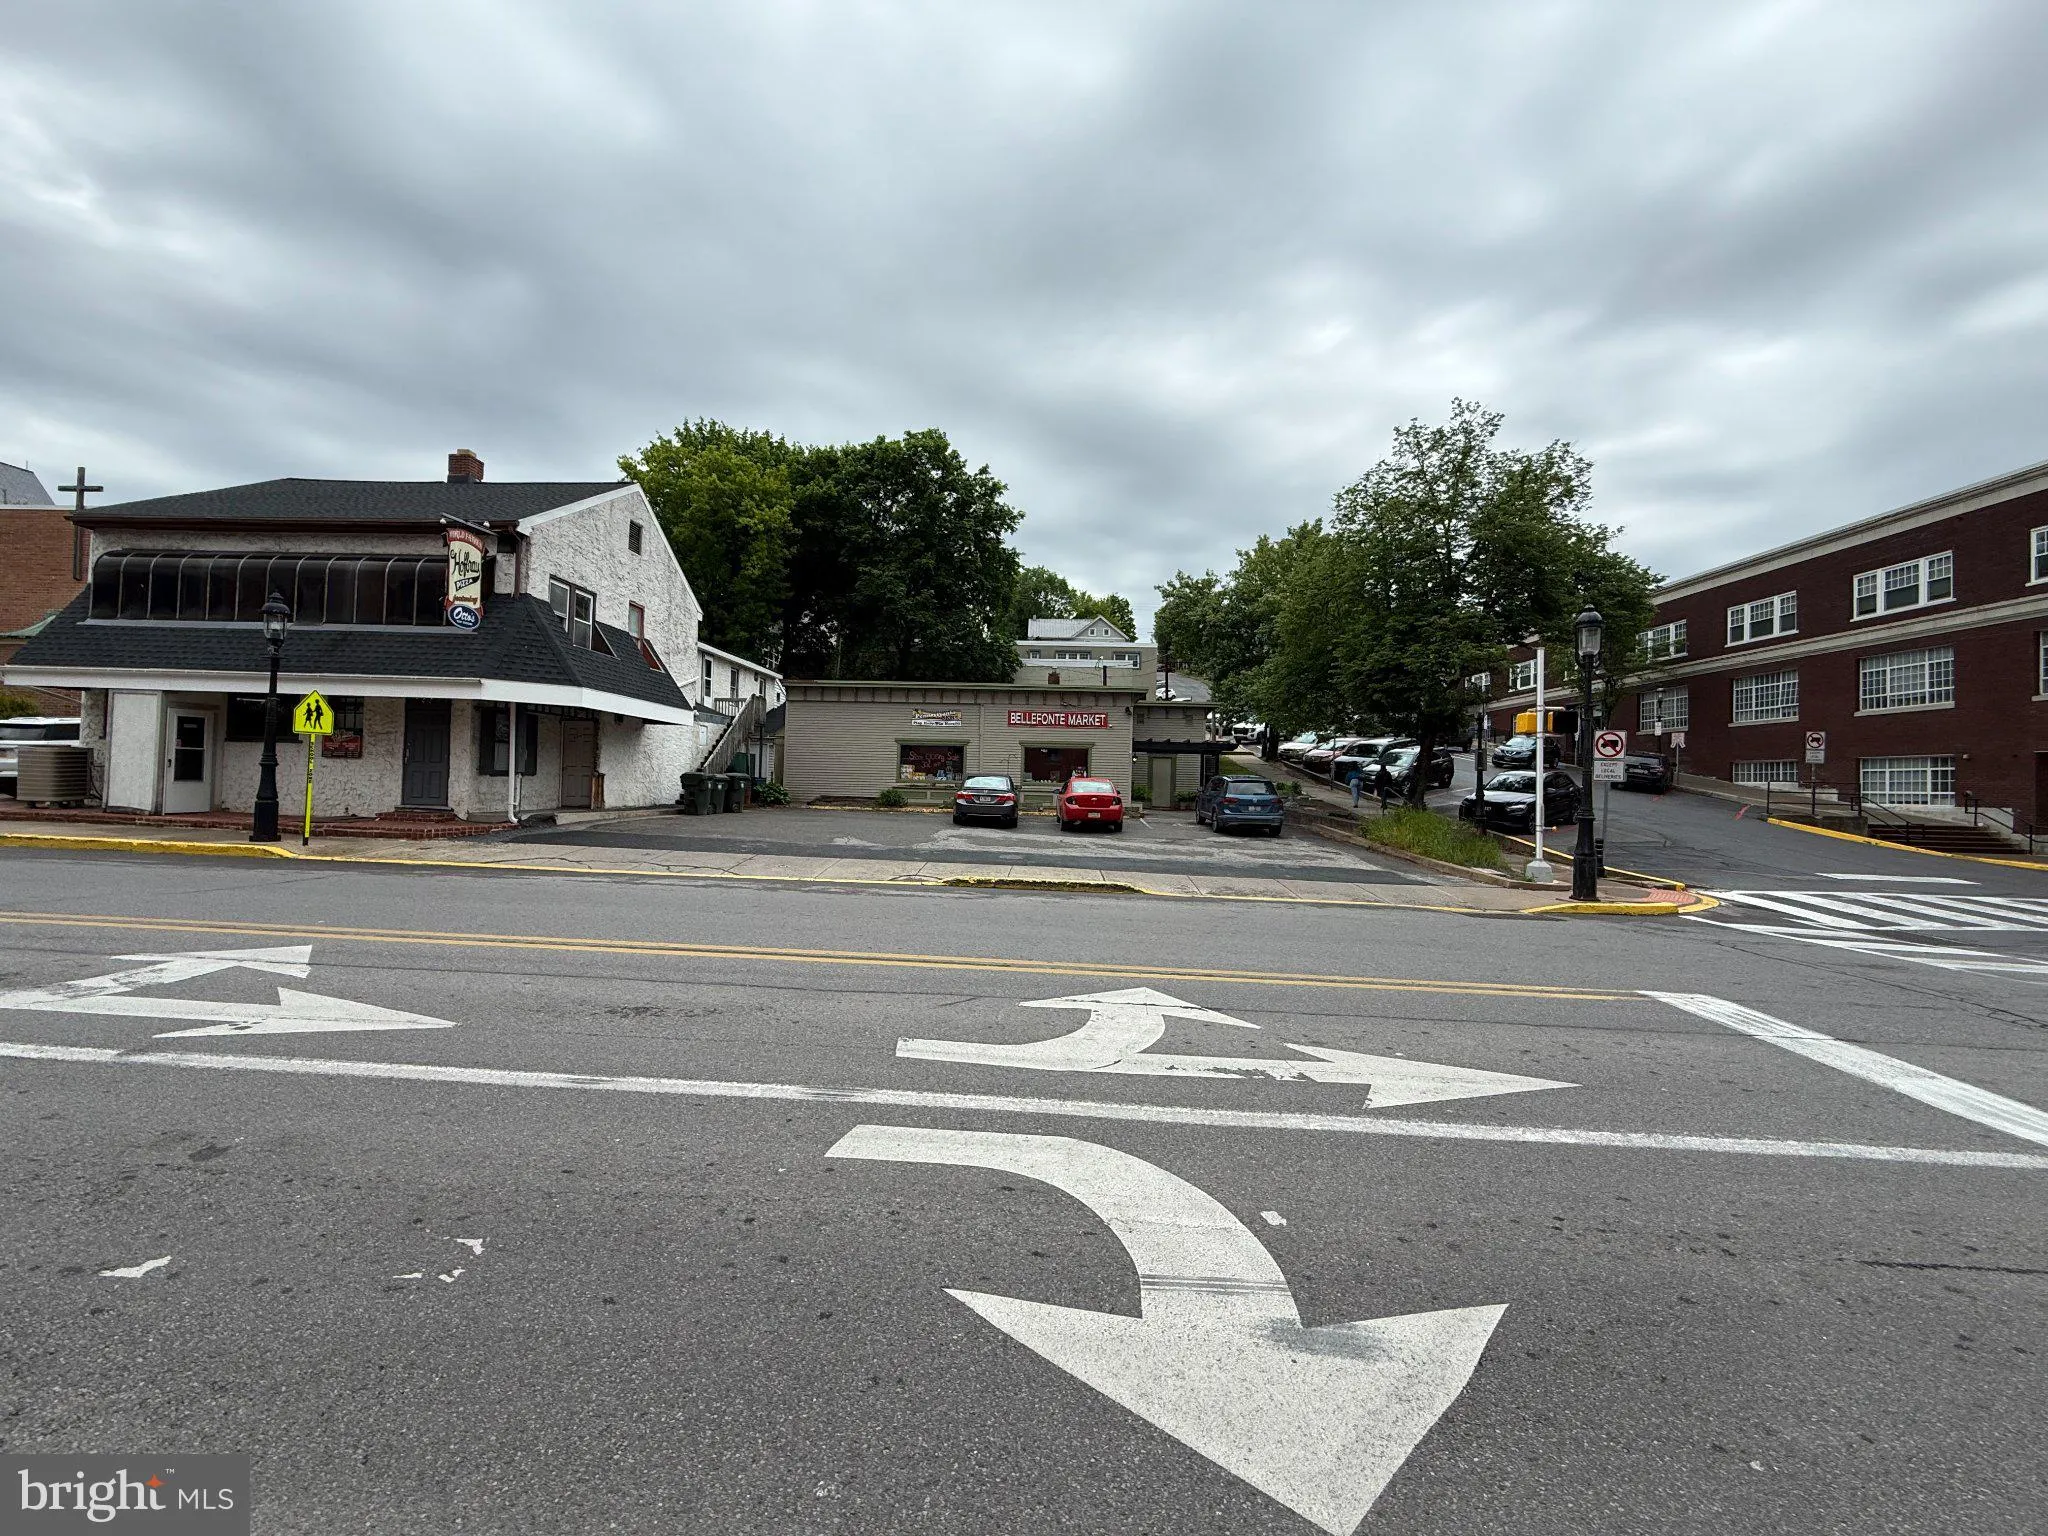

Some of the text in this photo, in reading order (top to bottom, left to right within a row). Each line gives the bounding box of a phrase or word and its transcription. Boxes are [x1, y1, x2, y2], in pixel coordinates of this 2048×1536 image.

[456, 579, 474, 589] PIZZA
[1010, 712, 1106, 727] BELLEFONTE MARKET
